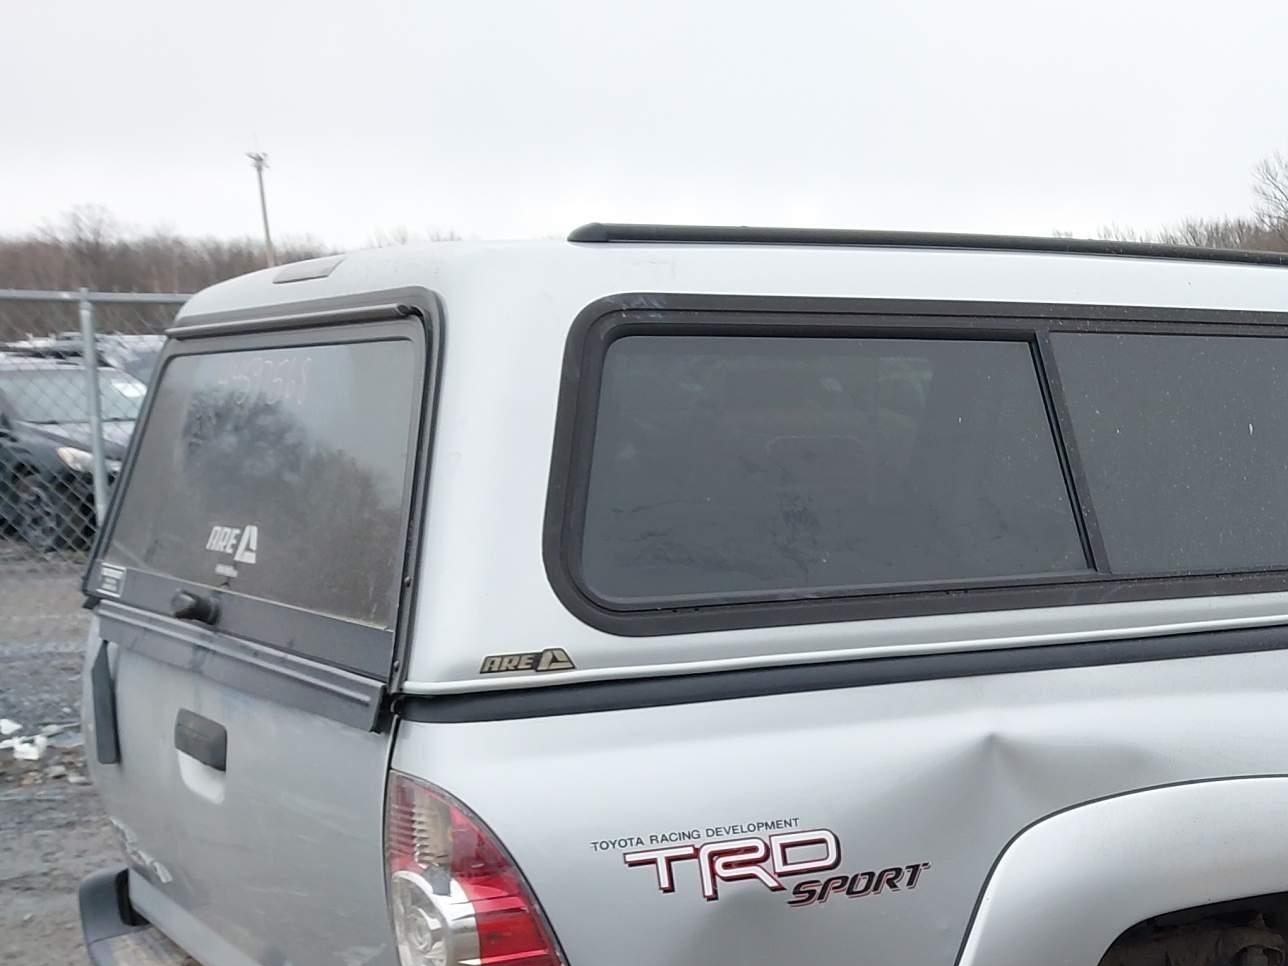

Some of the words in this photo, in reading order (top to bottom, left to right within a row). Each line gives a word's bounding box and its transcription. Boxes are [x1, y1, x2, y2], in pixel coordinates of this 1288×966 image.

[481, 655, 536, 673] ARE
[591, 837, 644, 852] TOYOTA
[650, 829, 700, 845] RACING
[706, 817, 800, 838] DEVELOPMENT
[623, 828, 842, 902] TRD
[787, 862, 931, 907] SPORT
